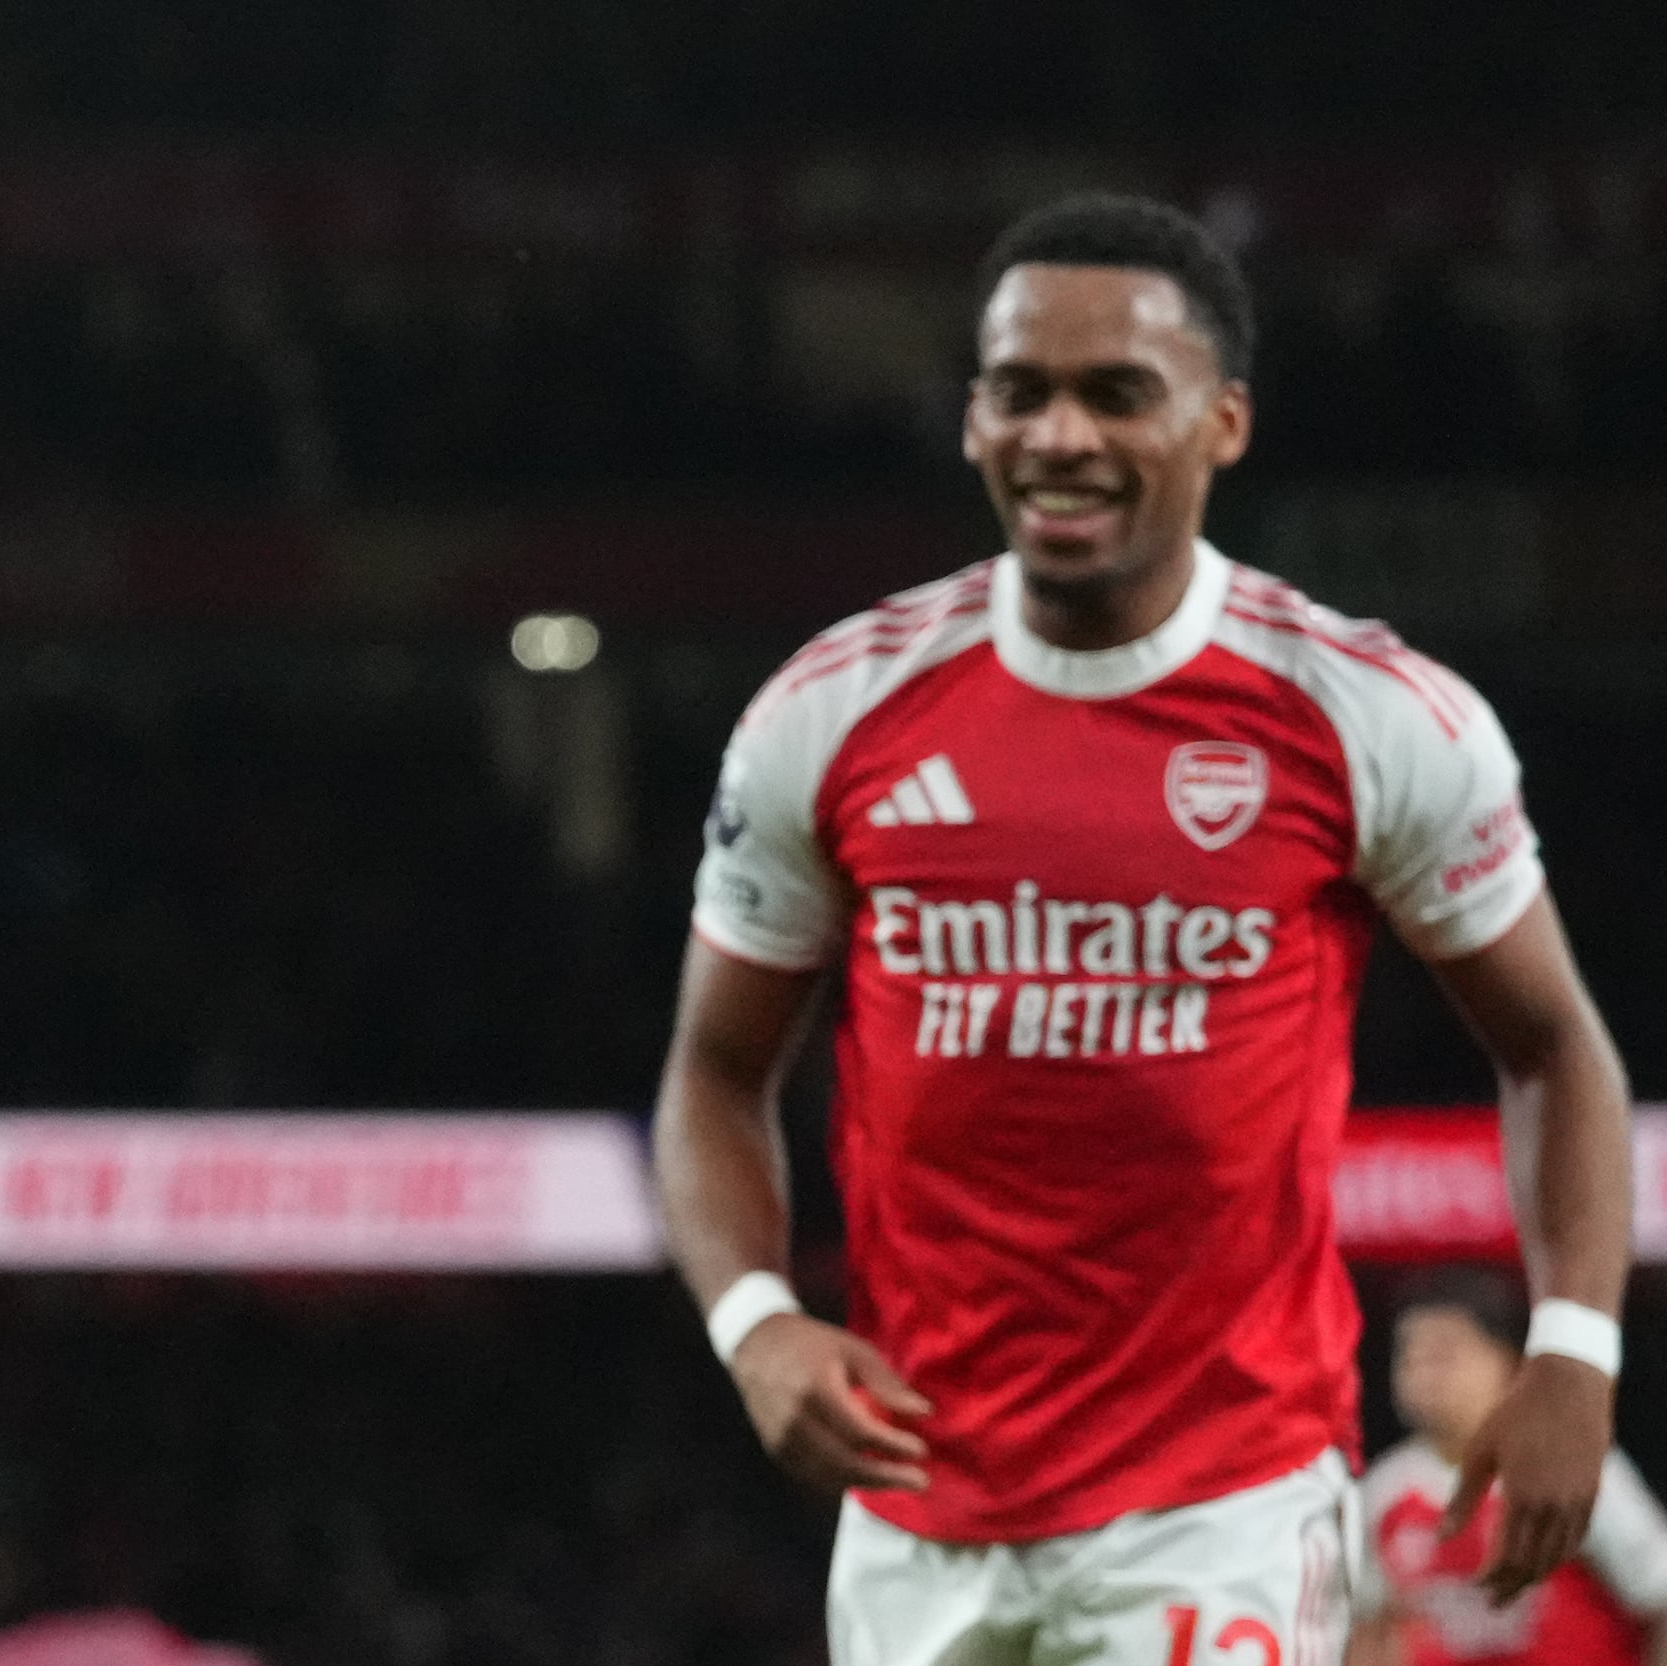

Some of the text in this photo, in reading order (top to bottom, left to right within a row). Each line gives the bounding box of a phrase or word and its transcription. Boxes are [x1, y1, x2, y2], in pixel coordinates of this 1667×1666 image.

[871, 880, 1275, 978] Emirates
[916, 983, 1209, 1058] FLY BETTER
